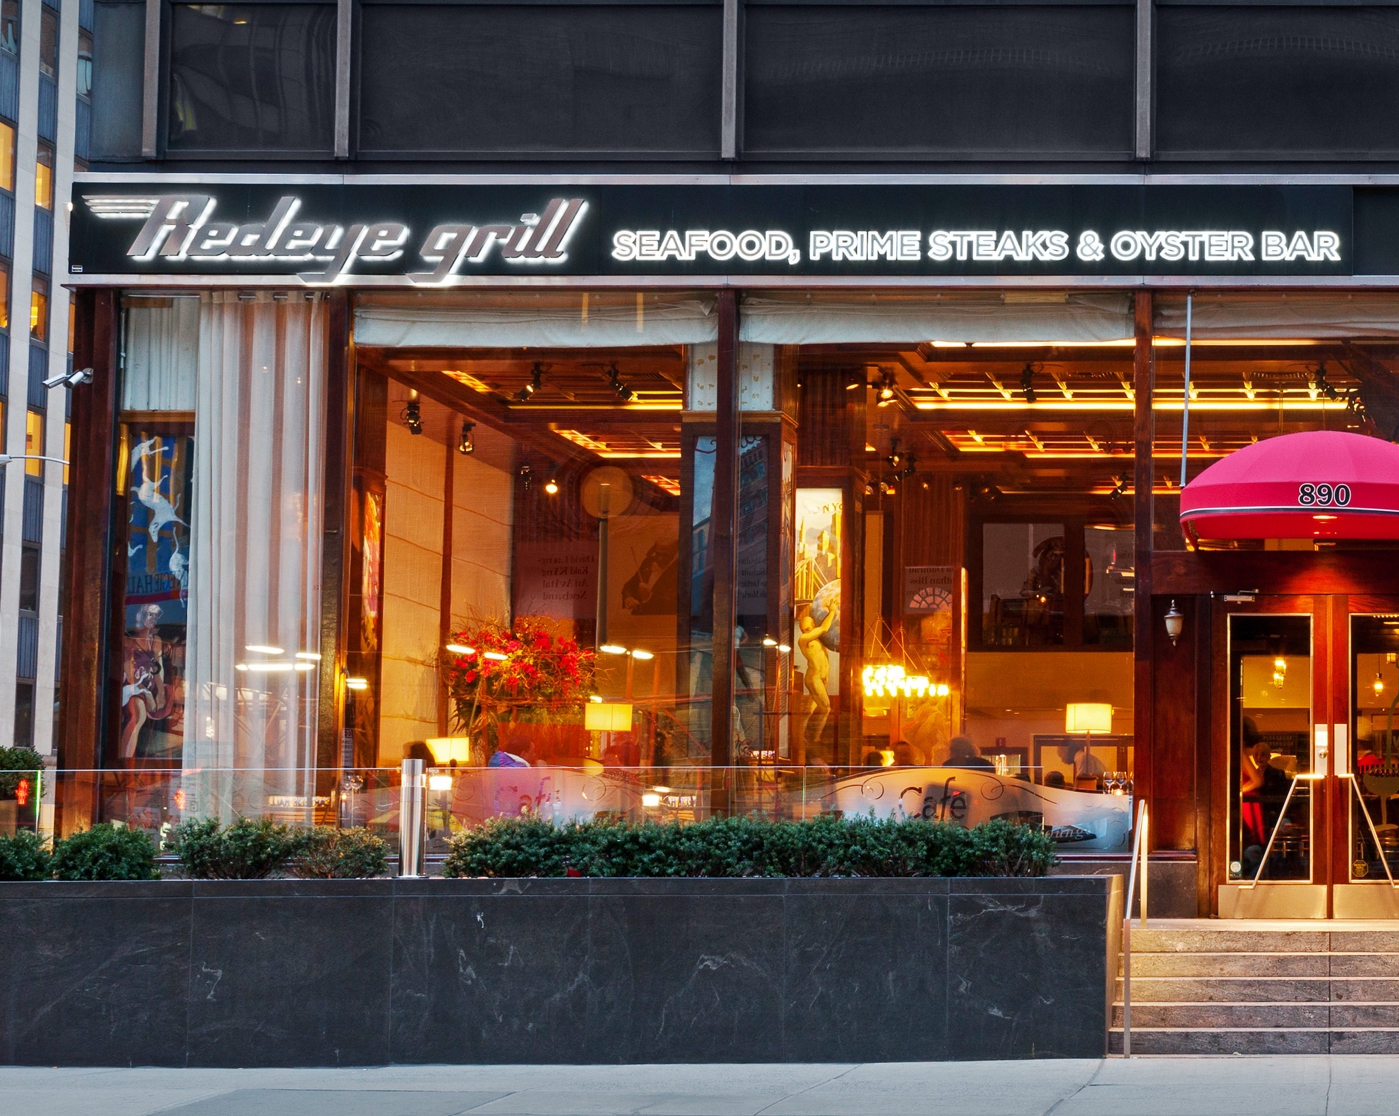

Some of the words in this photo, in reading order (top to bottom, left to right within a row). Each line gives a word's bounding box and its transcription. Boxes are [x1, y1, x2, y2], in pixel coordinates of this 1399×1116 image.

[82, 195, 407, 285] Redeye
[405, 198, 589, 285] grill
[611, 229, 801, 265] SEAFOOD,
[809, 229, 922, 262] PRIME
[927, 229, 1069, 262] STEAKS
[1076, 229, 1105, 262] &
[1110, 229, 1252, 262] OYSTER
[1260, 229, 1341, 262] BAR
[1298, 483, 1351, 507] 890
[898, 776, 967, 822] Café
[1044, 828, 1089, 841] oung
